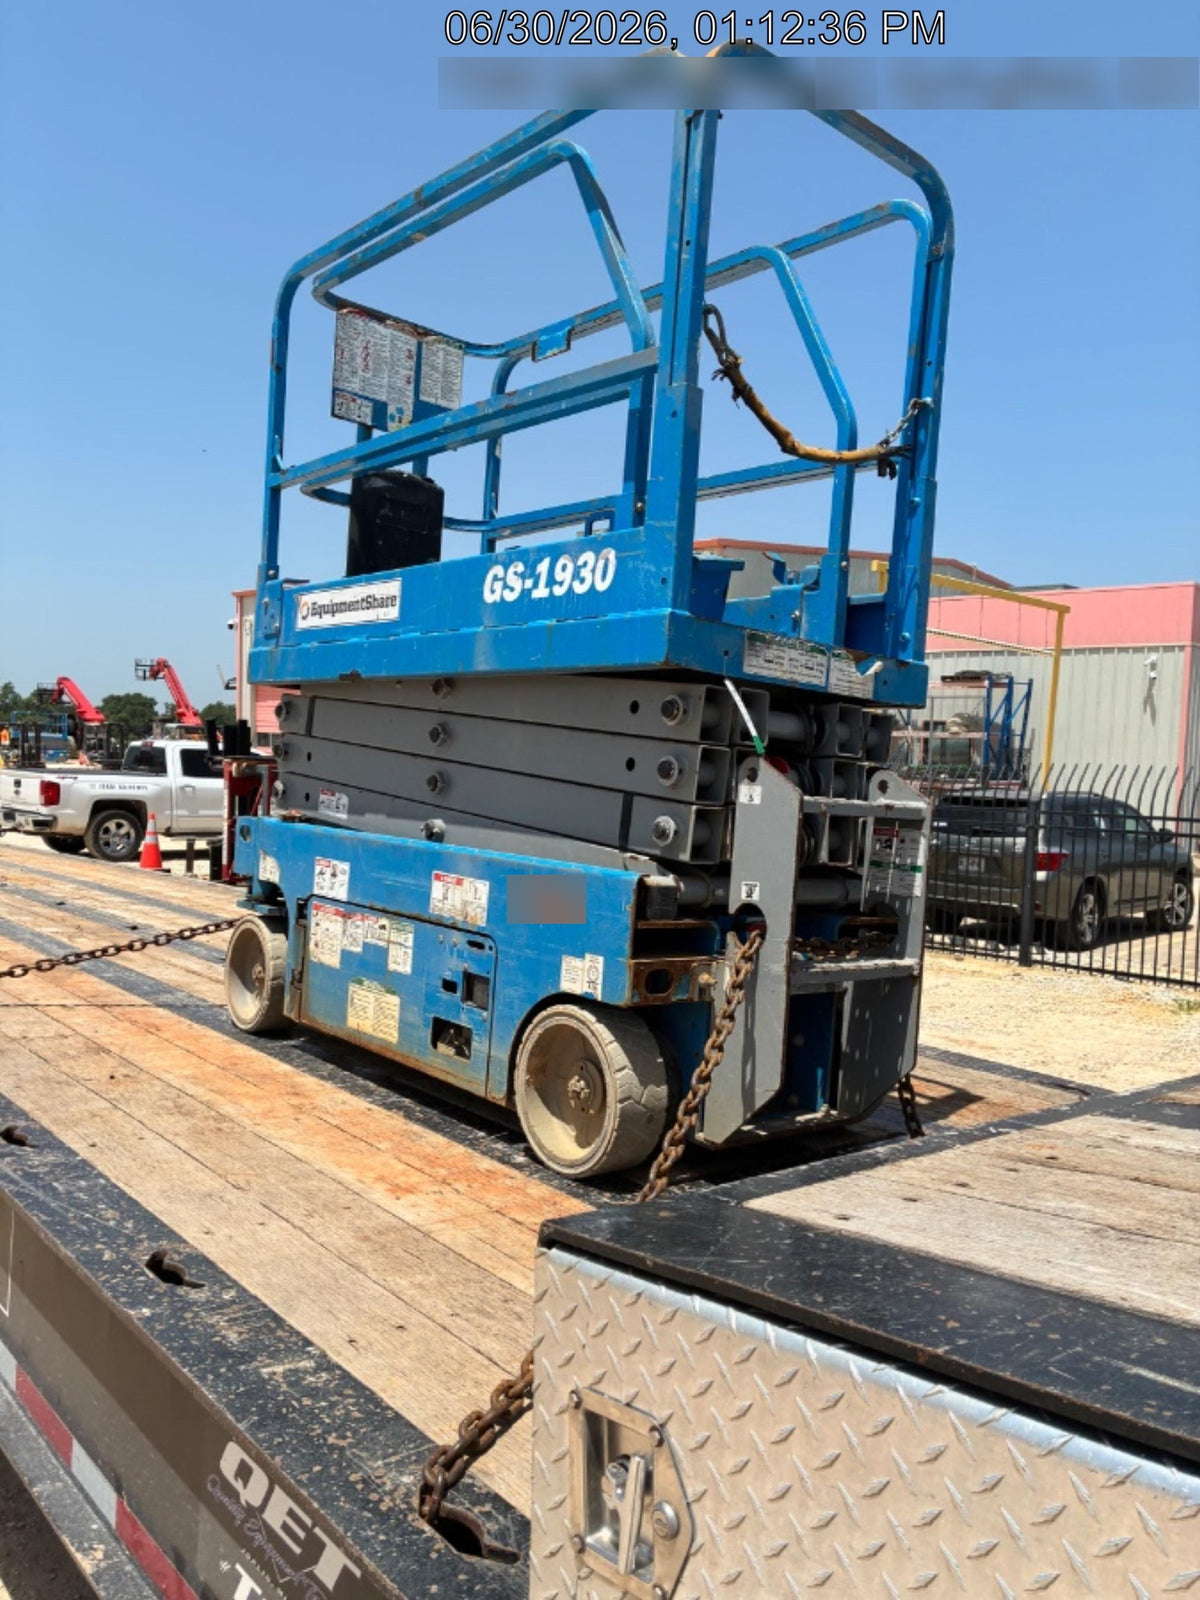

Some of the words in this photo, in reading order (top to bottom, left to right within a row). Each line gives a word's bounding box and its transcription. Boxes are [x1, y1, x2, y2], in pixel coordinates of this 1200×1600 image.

[483, 547, 616, 603] GS-1930
[310, 593, 397, 617] EquipmentShare
[219, 1440, 362, 1593] QET
